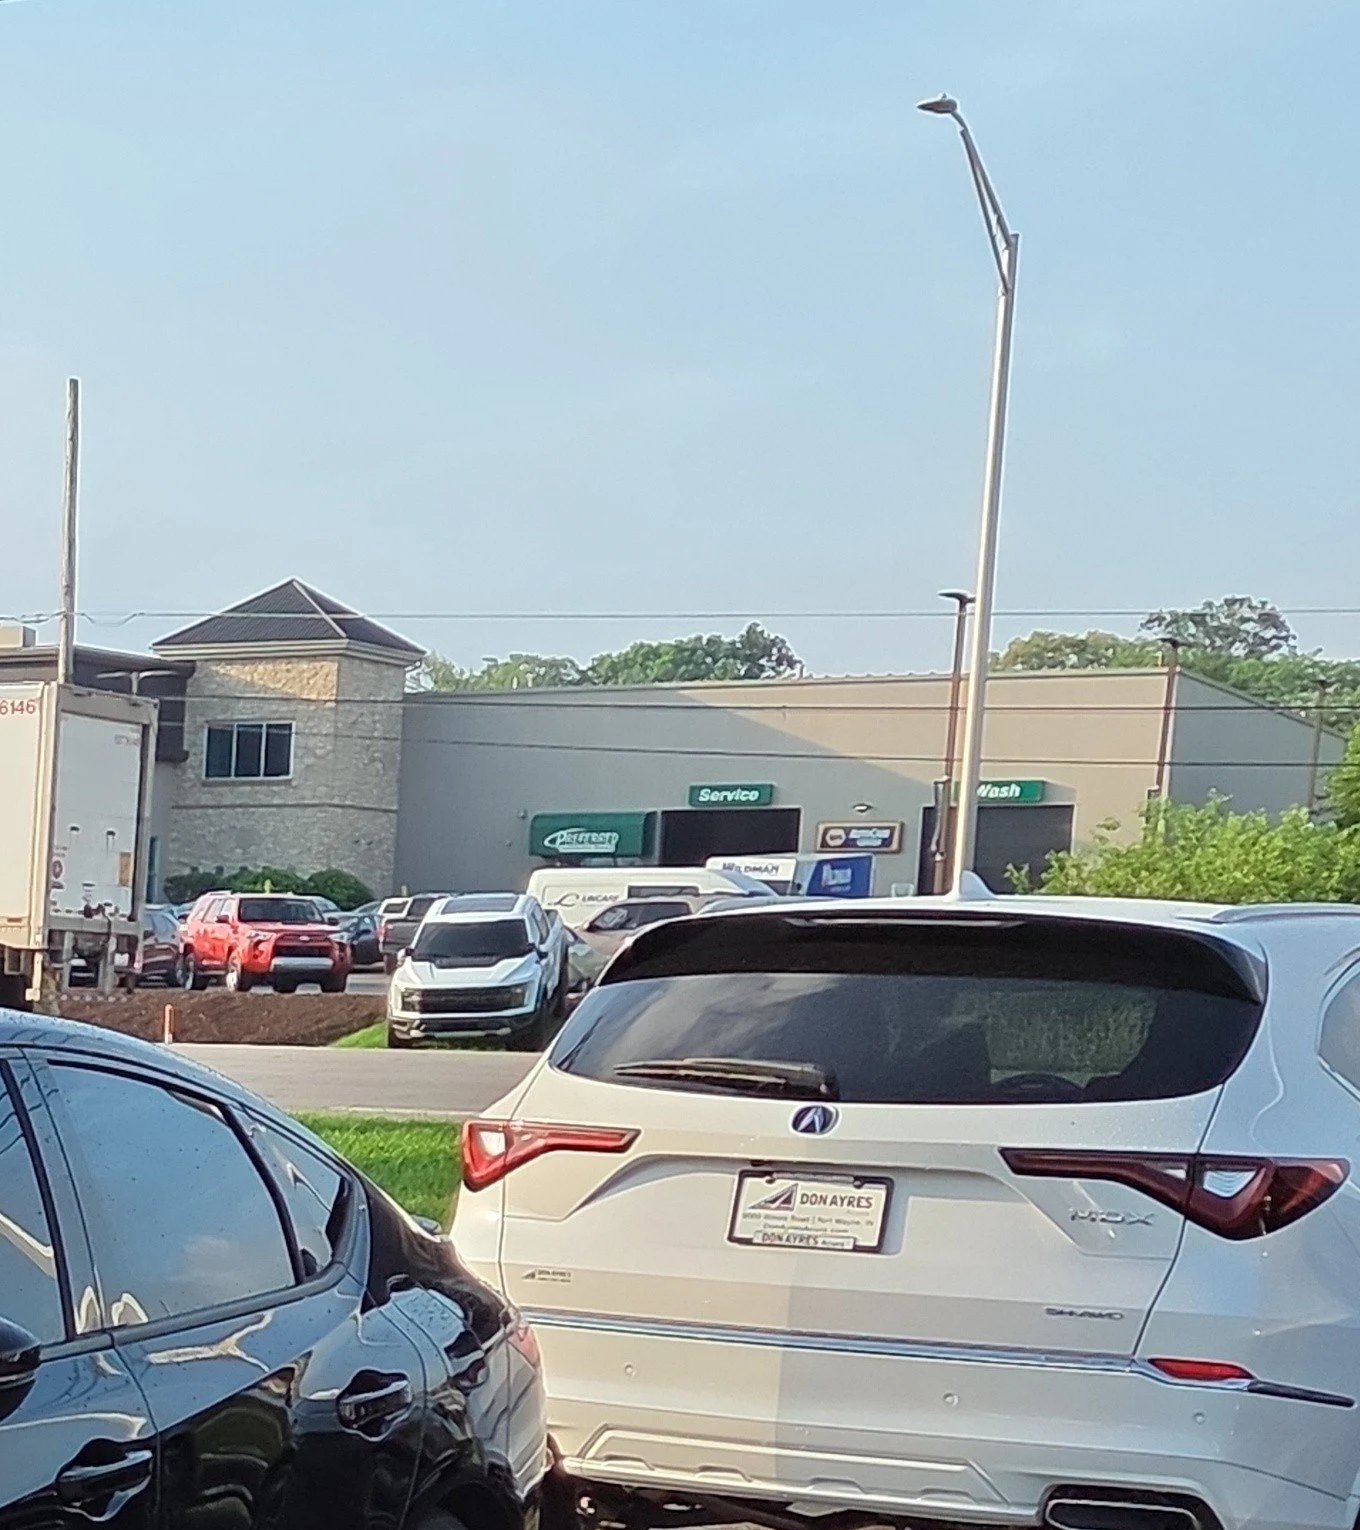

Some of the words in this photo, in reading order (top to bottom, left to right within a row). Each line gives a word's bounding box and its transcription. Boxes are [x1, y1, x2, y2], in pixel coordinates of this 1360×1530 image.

[698, 787, 759, 802] Service
[800, 1193, 828, 1206] DON
[829, 1194, 874, 1209] AYRES
[762, 1232, 783, 1242] DON
[785, 1234, 818, 1246] AYRES
